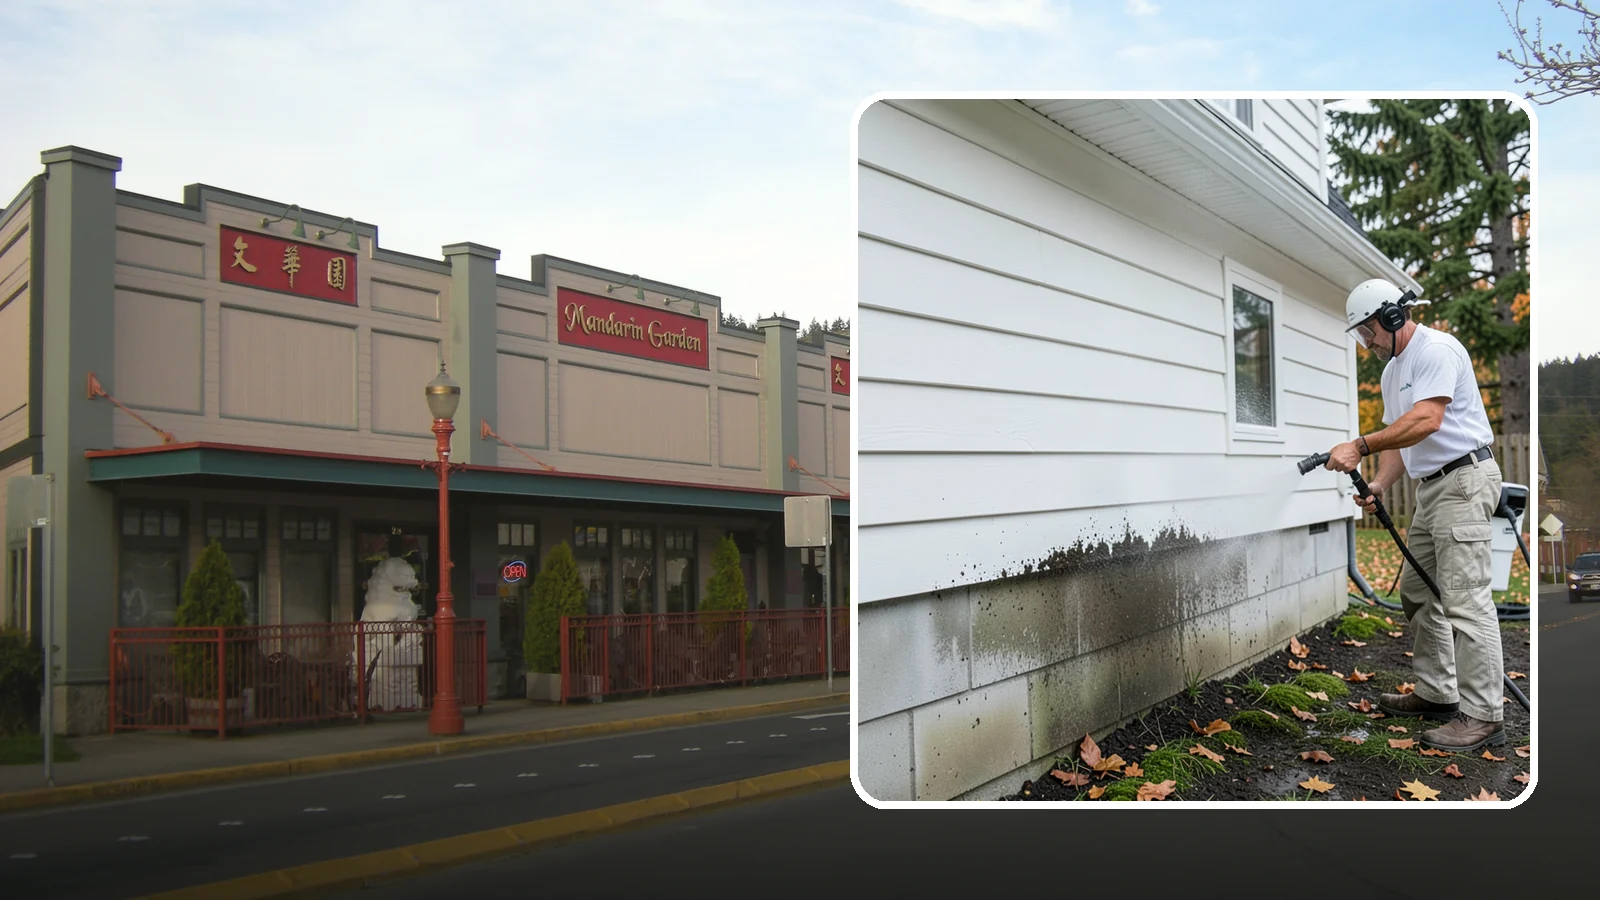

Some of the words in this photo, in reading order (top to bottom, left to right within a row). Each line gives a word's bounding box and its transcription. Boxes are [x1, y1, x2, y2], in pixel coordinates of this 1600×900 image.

[231, 235, 346, 290] 文華園
[564, 302, 644, 341] Mandarin
[648, 320, 701, 352] Garden
[834, 363, 846, 386] 文
[503, 565, 527, 578] OPEN
